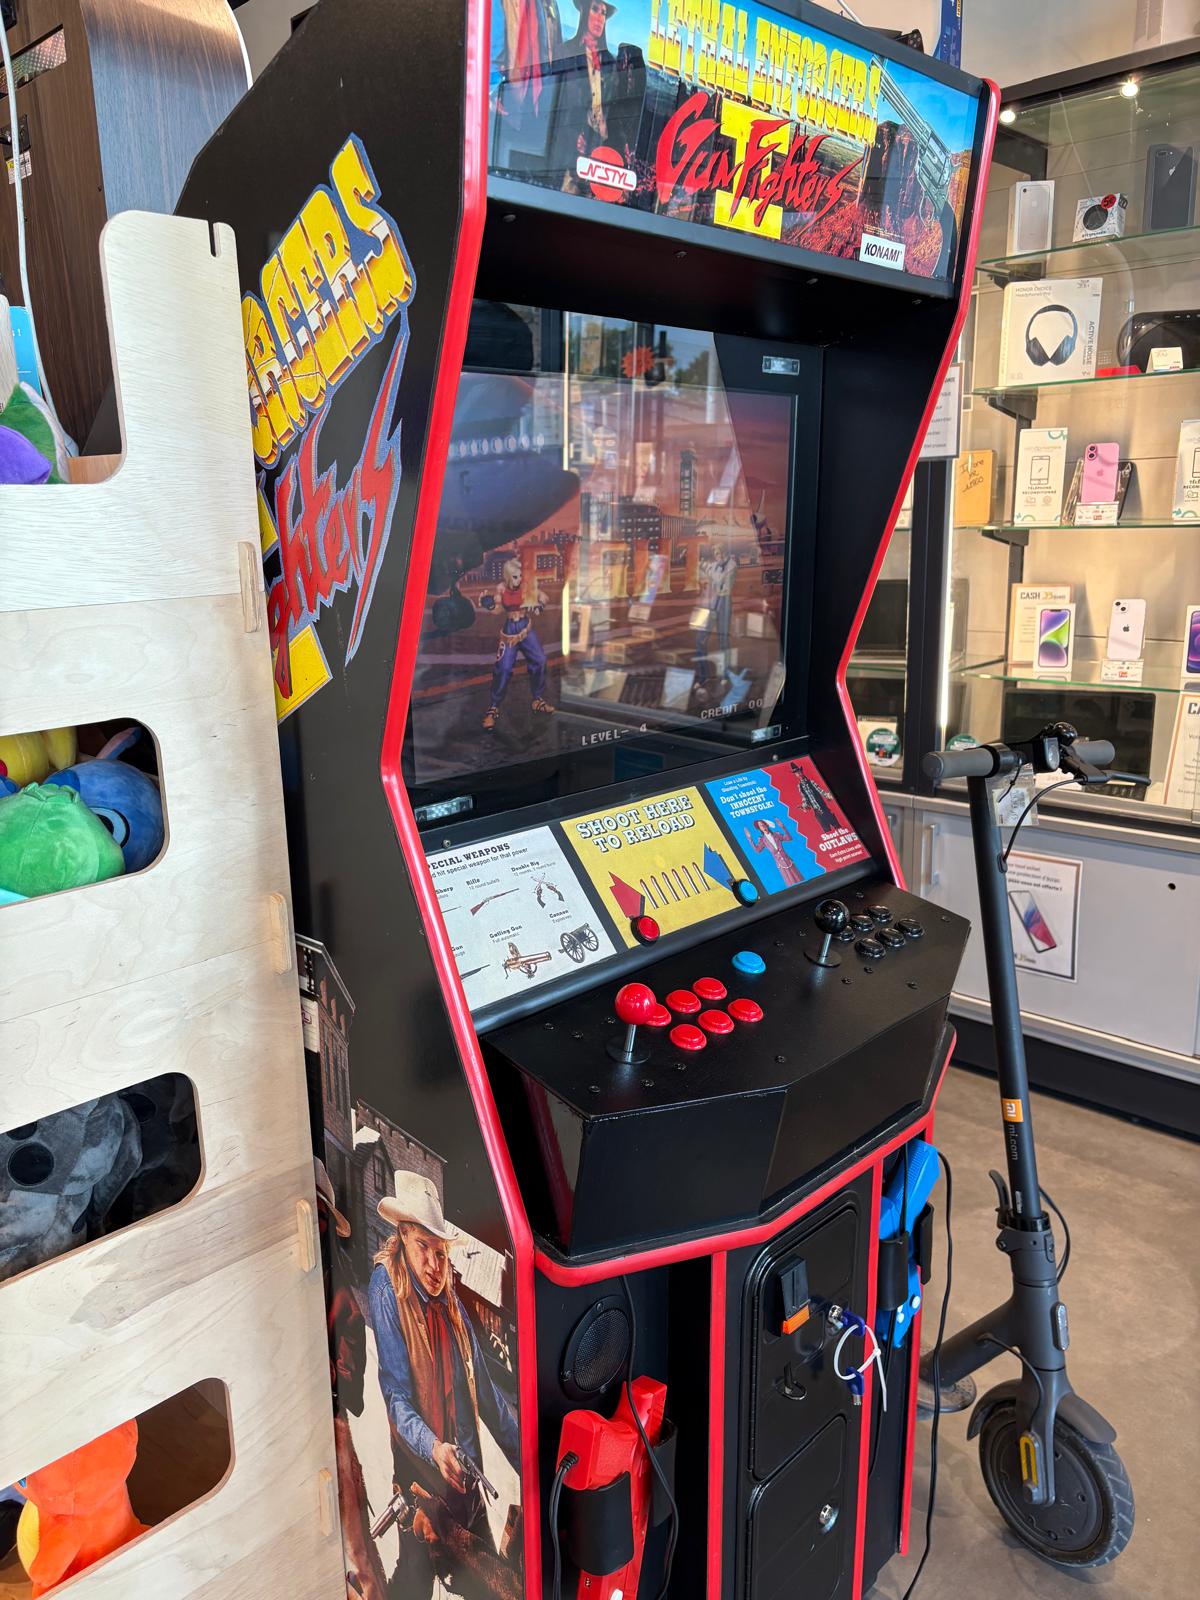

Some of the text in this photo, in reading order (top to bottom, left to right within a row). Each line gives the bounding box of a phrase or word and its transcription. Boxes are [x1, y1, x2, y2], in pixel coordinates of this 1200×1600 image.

[648, 0, 881, 148] LETHAL ENFORCERS
[864, 242, 900, 262] KONAMI
[701, 699, 763, 720] CREDIT 00
[640, 723, 647, 732] 4
[720, 793, 739, 804] Don't
[739, 788, 756, 799] shoot
[730, 793, 766, 810] INNOCENT
[576, 795, 694, 839] SHOOT HERE
[729, 801, 775, 818] TOWNSFOLK!
[593, 813, 695, 852] TO RELOAD
[819, 832, 859, 851] OUTLAWS
[821, 830, 839, 841] Shoot
[463, 843, 511, 861] WEAPONS
[446, 863, 468, 876] special
[468, 858, 491, 869] weapon
[499, 851, 512, 860] that
[511, 847, 529, 857] power
[511, 863, 530, 872] Double
[466, 878, 480, 886] Rifle
[549, 909, 569, 919] Cannon
[1008, 1124, 1018, 1160] mi.com
